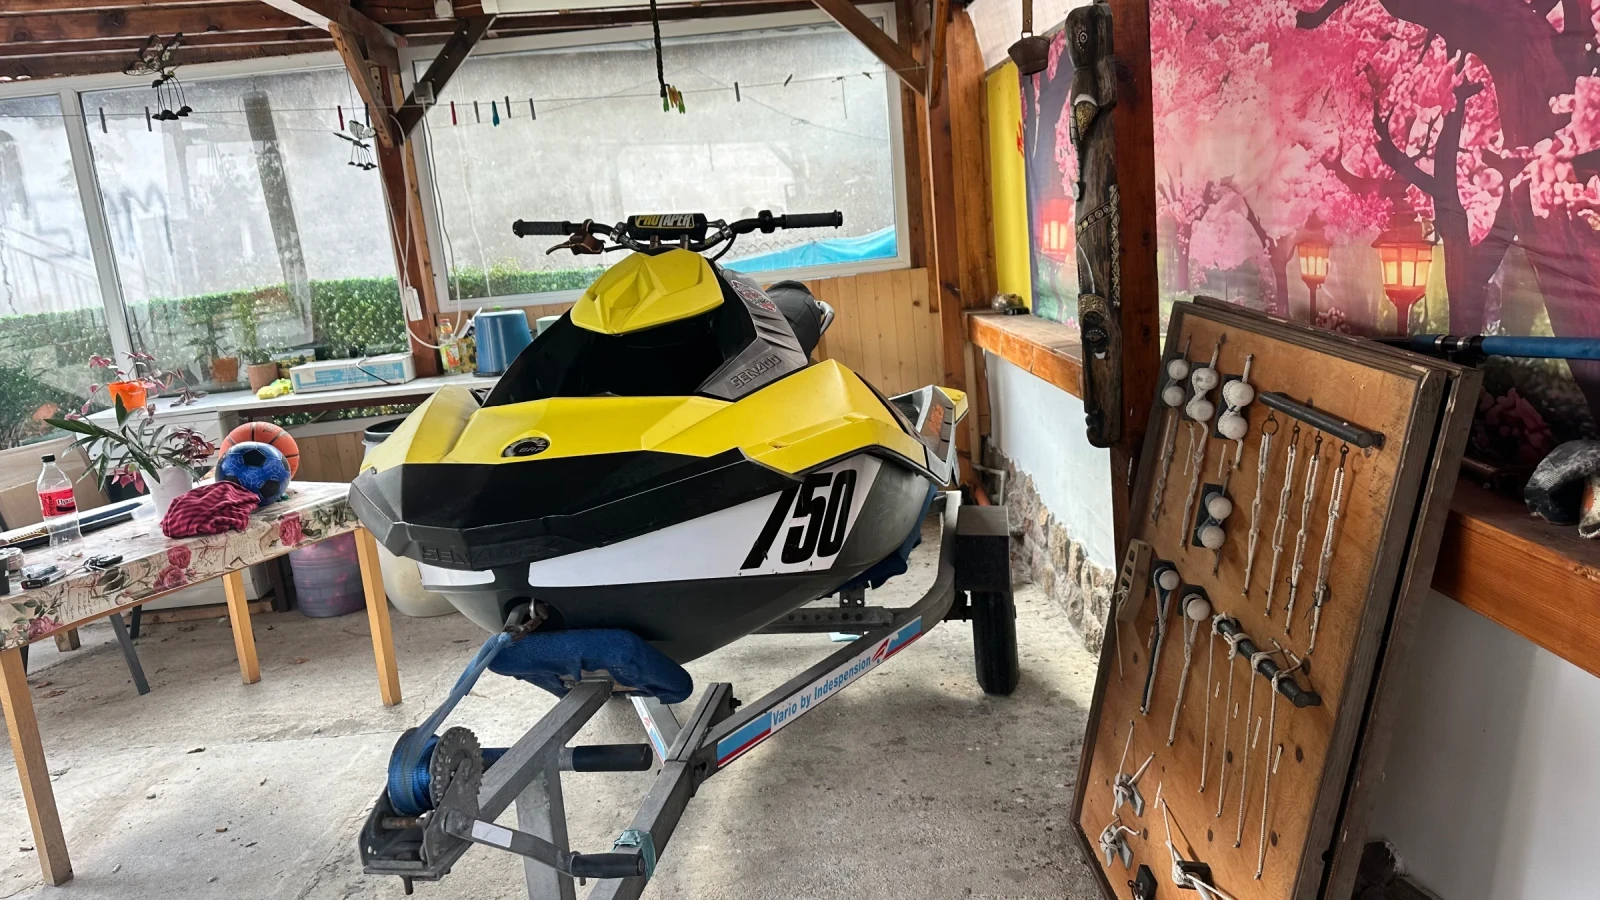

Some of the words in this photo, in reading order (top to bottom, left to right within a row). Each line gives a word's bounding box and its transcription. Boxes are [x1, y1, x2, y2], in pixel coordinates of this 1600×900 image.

[773, 702, 797, 726] Vario
[800, 694, 811, 709] by
[814, 655, 871, 700] Indespension
